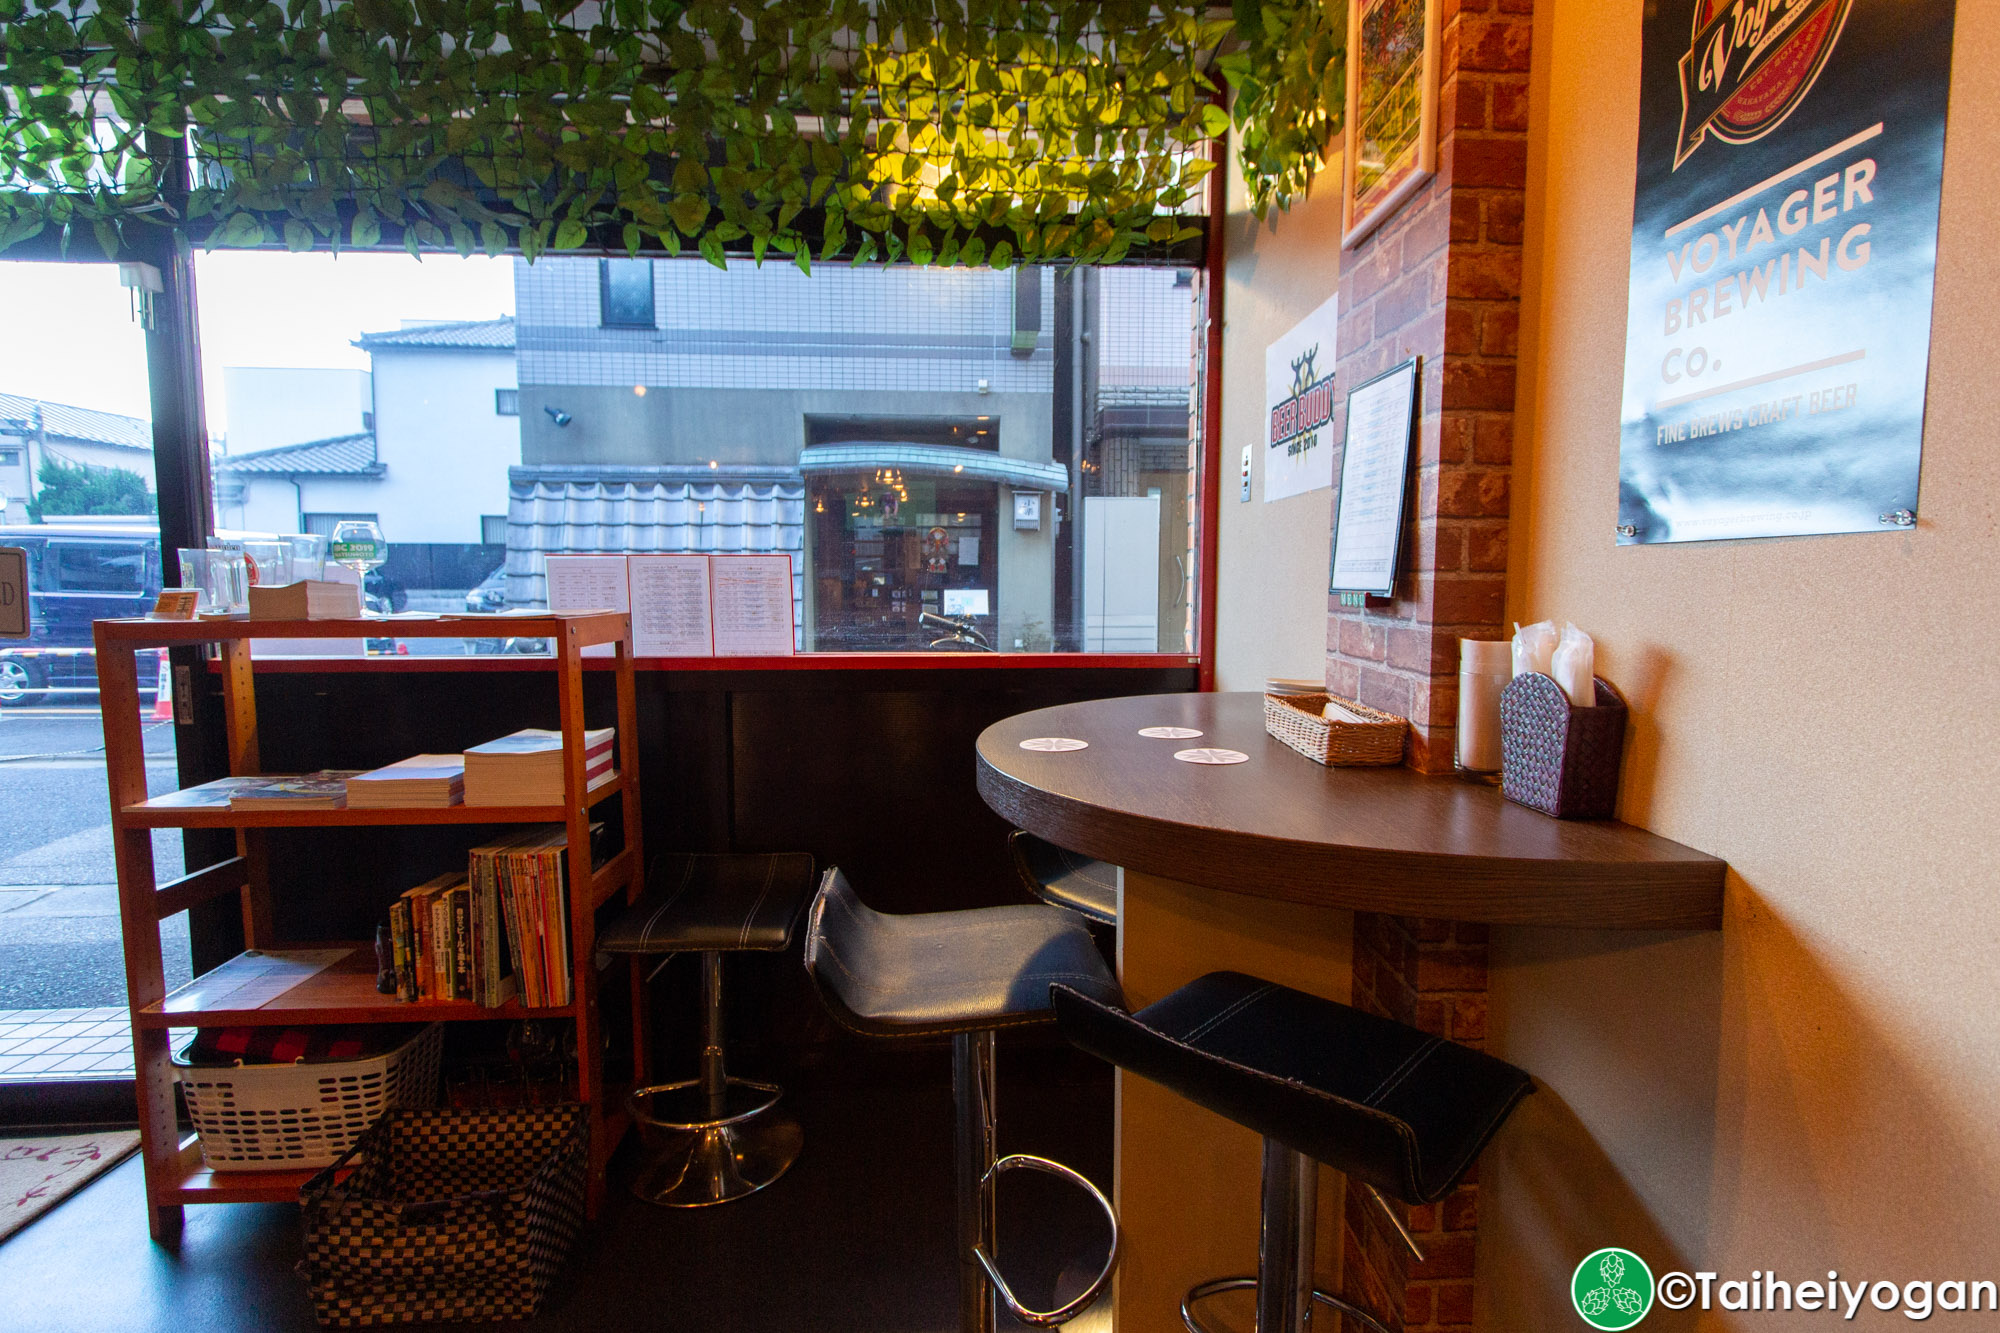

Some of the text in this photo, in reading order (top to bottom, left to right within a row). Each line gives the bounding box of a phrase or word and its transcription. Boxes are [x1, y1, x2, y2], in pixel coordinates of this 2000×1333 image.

[1666, 158, 1877, 284] VOYAGER
[1664, 223, 1872, 337] BREWING
[1661, 346, 1722, 385] CO.
[1272, 400, 1297, 443] BEER
[1656, 383, 1857, 446] FINE BREWS CRAFT BEER
[350, 544, 374, 552] 2019
